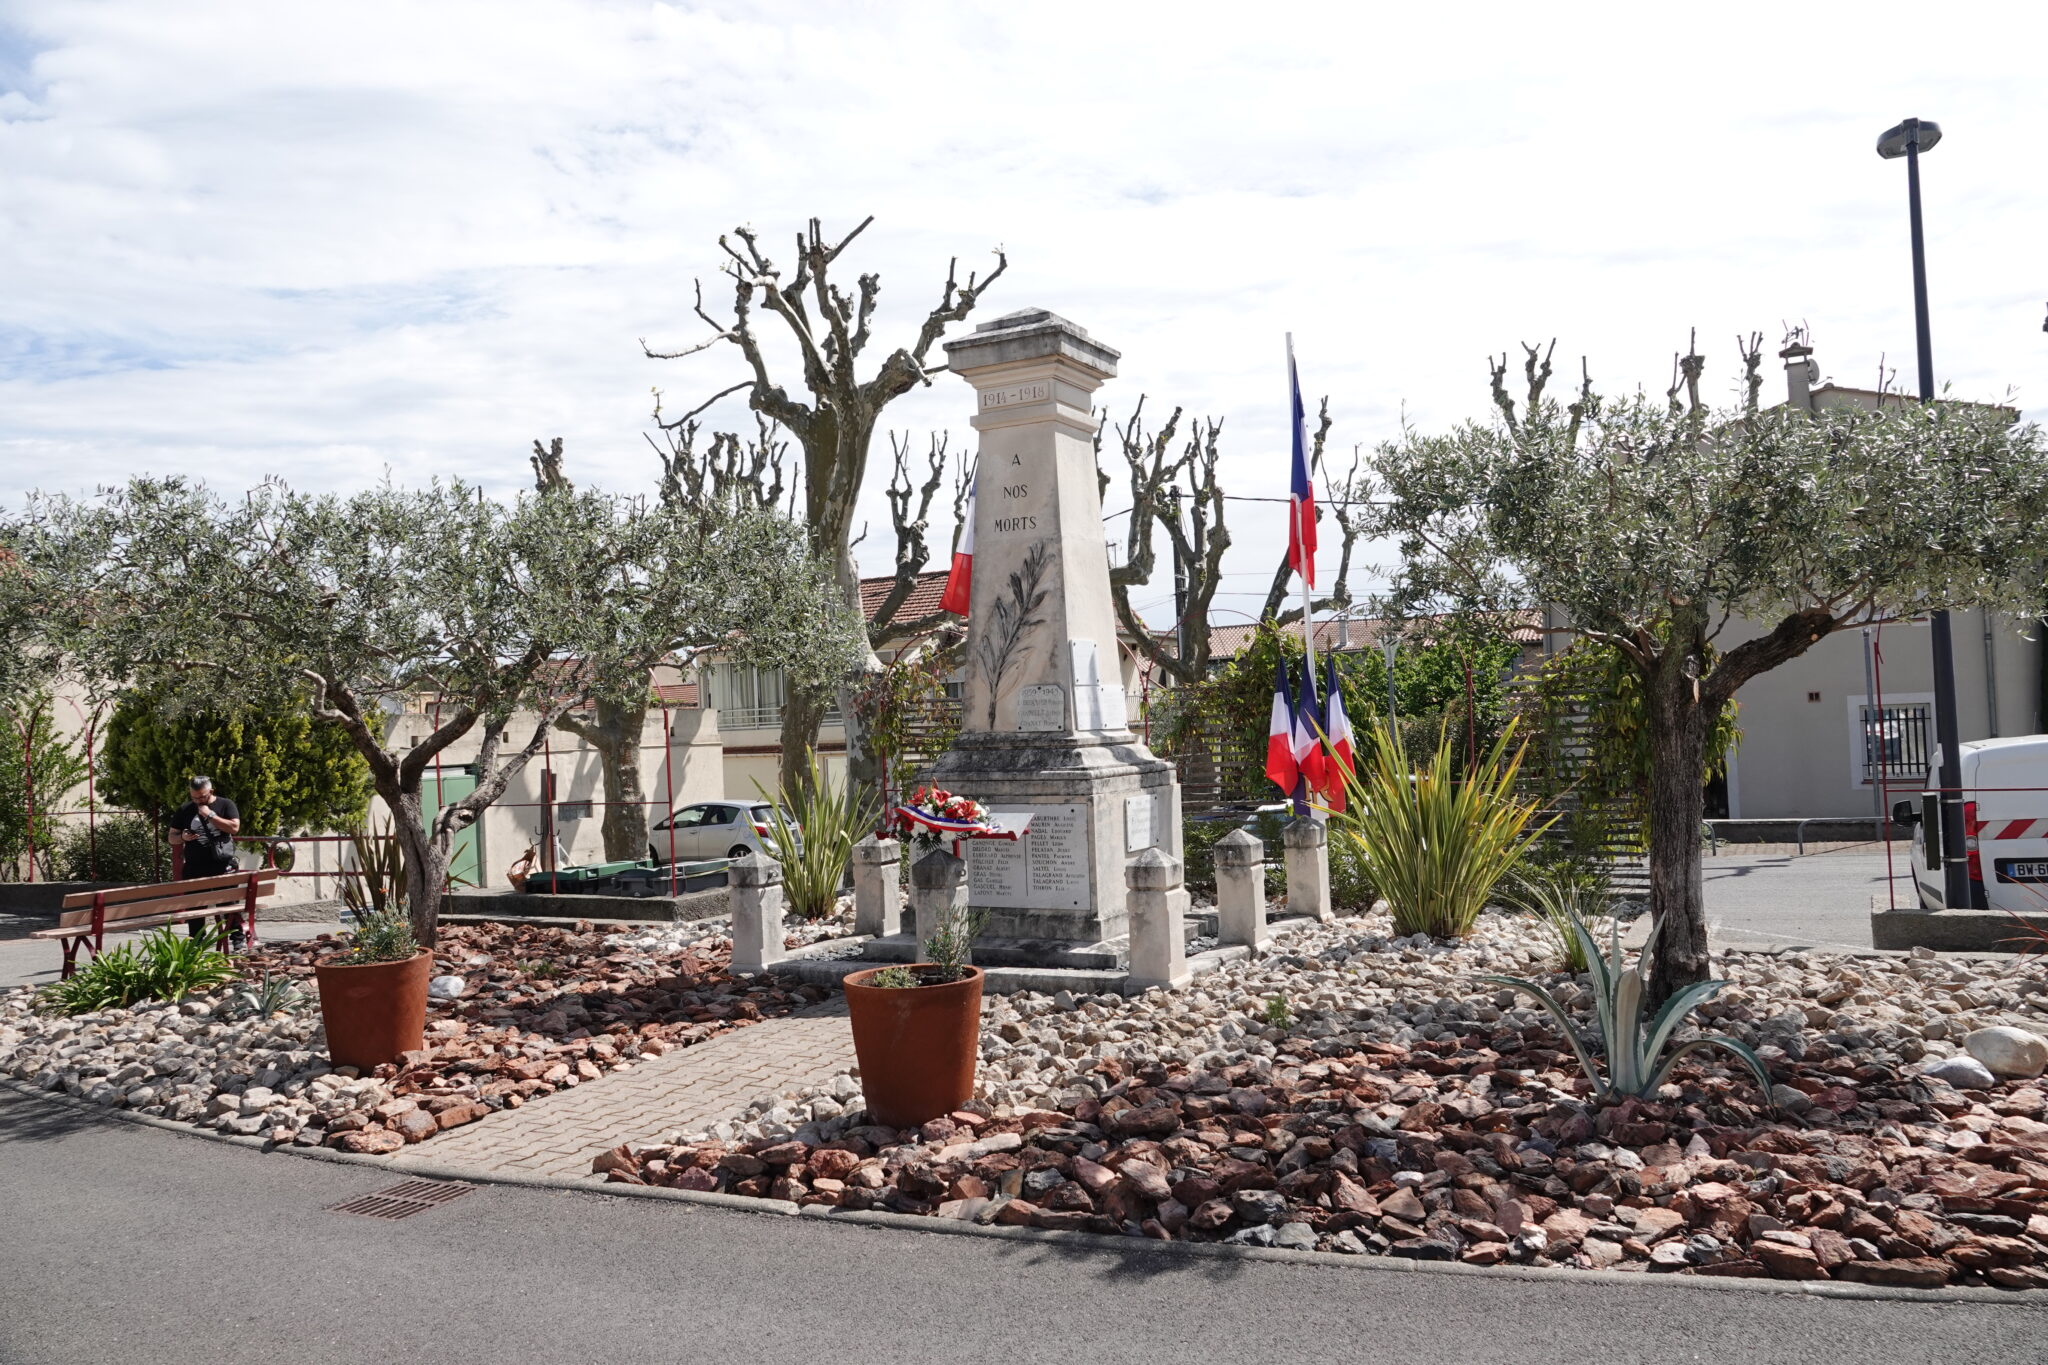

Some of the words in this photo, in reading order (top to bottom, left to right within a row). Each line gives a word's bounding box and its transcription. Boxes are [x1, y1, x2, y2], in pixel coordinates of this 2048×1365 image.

[1011, 453, 1022, 467] A
[1003, 484, 1028, 499] NOS
[994, 516, 1037, 532] MORTS
[2017, 864, 2048, 876] BW-6
